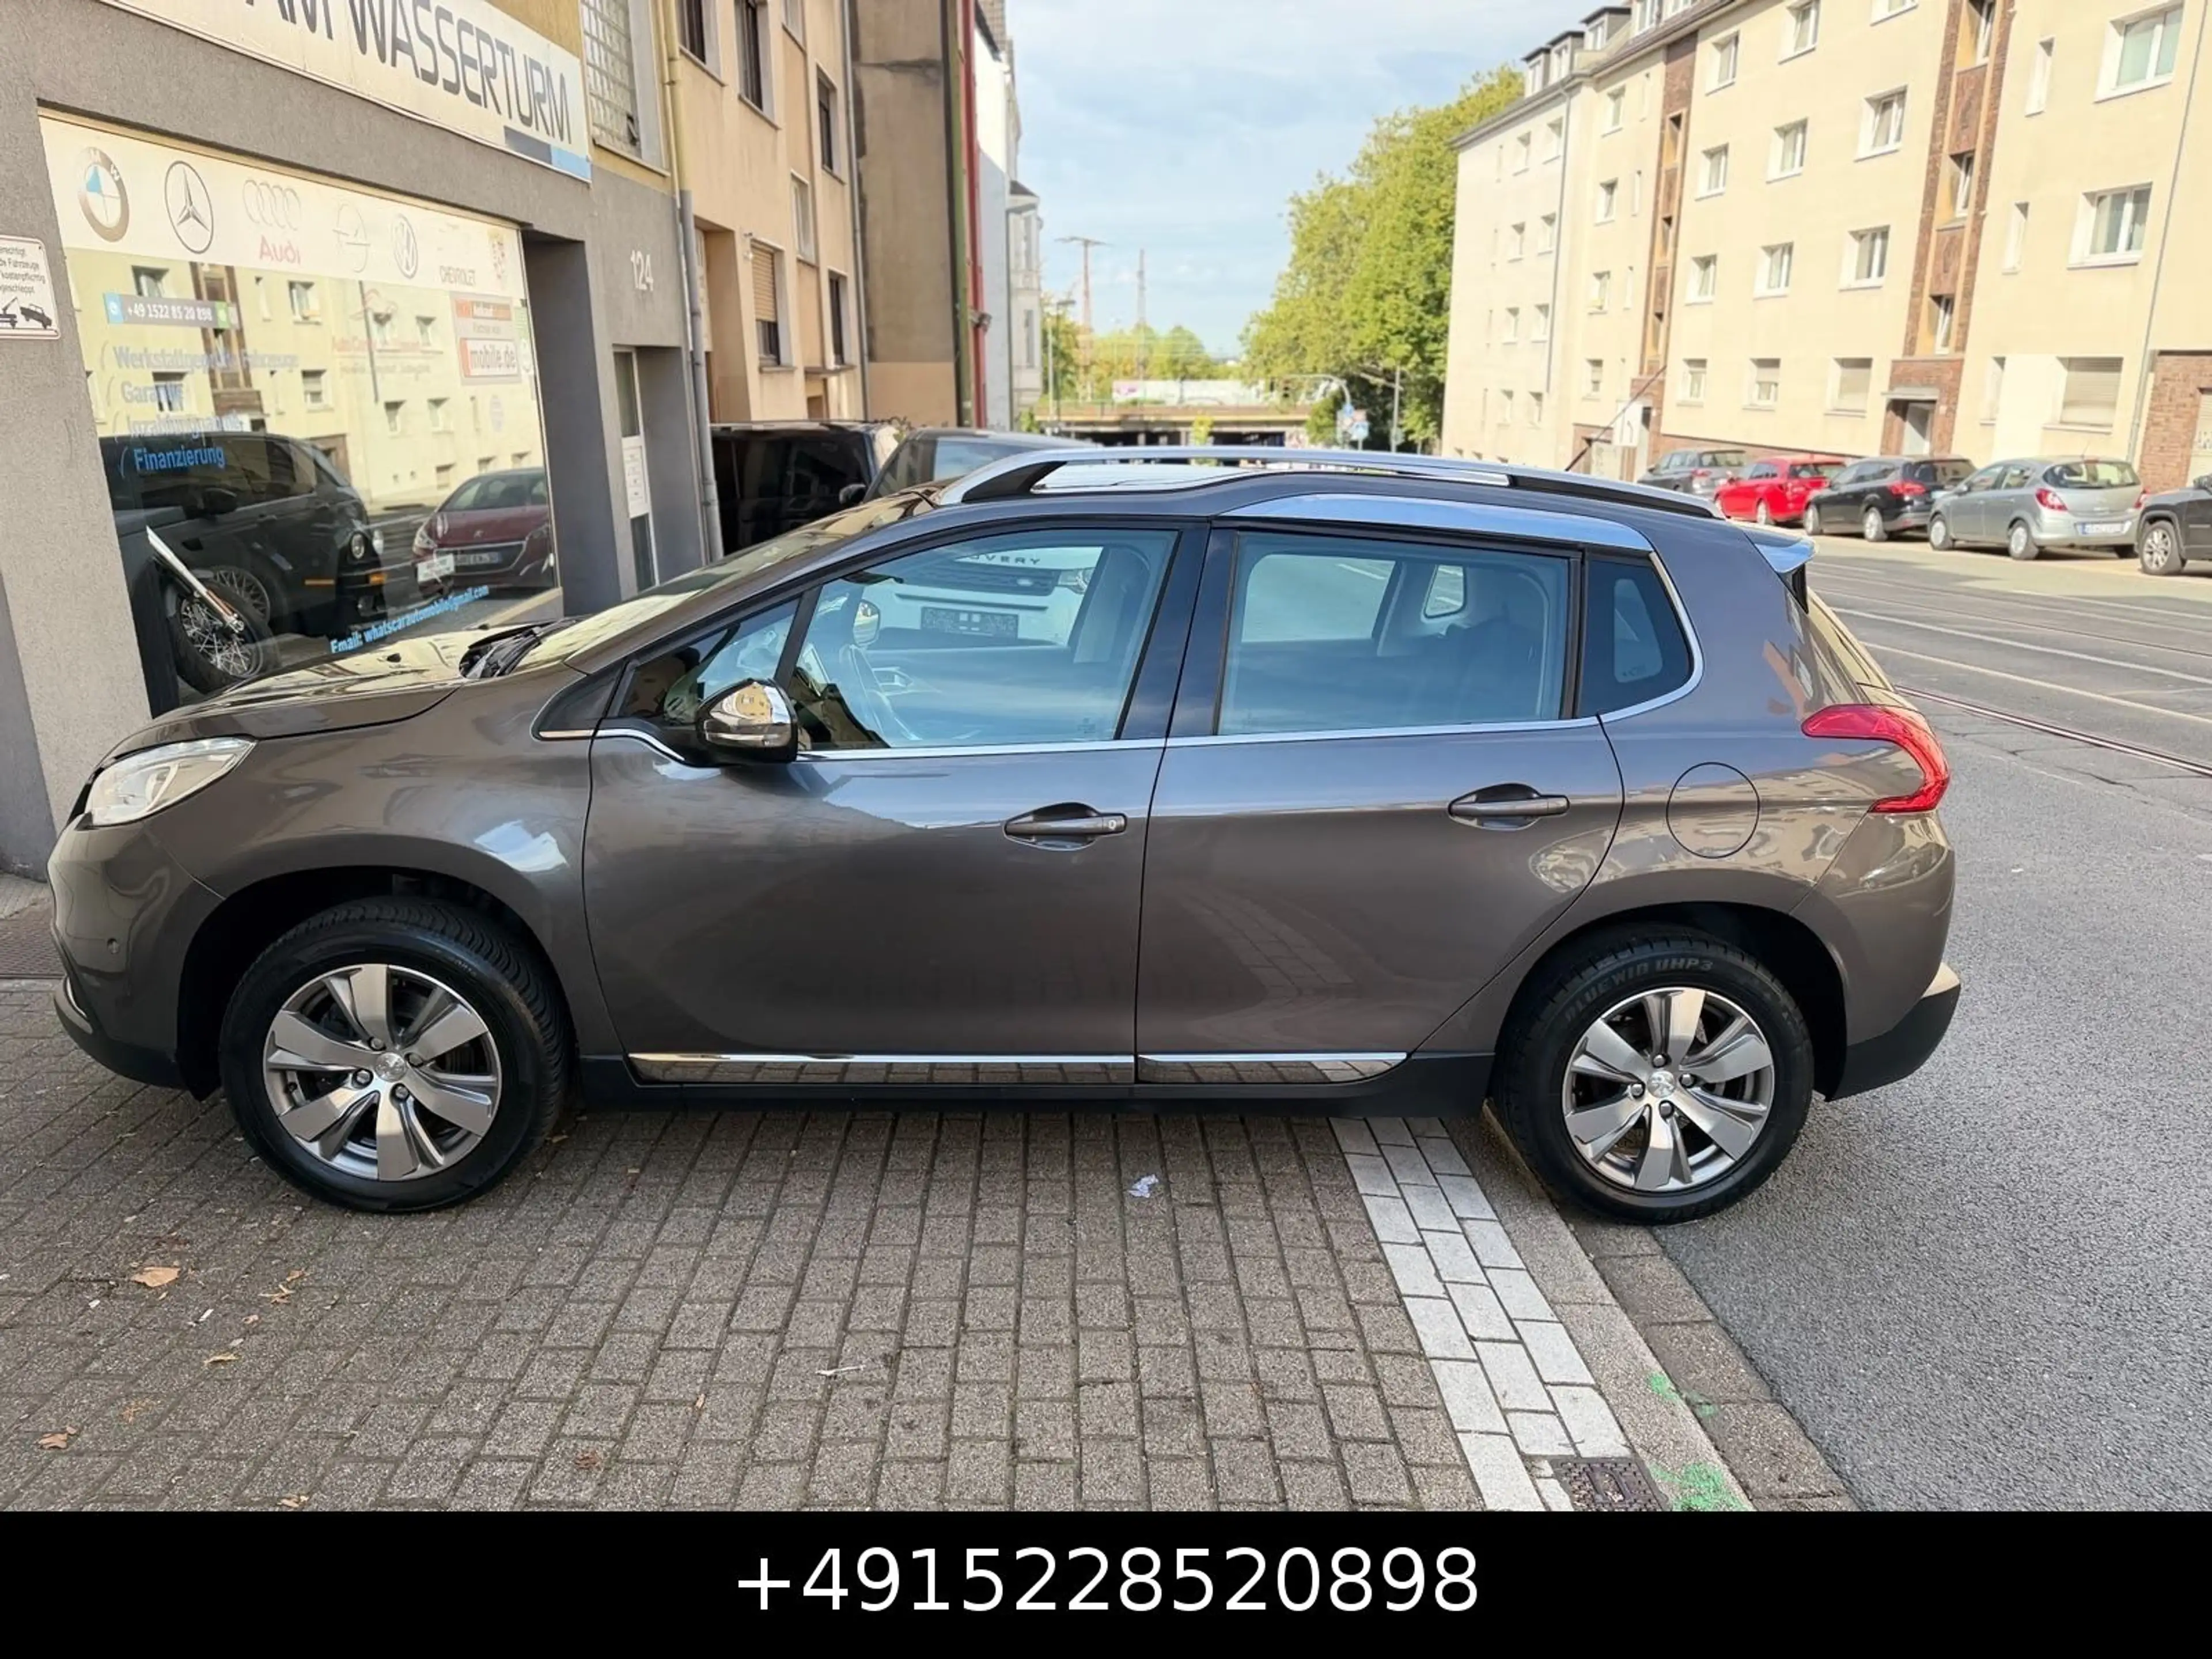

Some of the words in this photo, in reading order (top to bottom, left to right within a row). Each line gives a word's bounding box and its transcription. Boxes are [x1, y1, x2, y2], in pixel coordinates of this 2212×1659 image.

[348, 0, 572, 144] WASSERTURM
[260, 234, 301, 264] Audi
[630, 249, 654, 291] 124
[470, 344, 516, 370] mobile.de
[133, 445, 226, 472] Finanzierung
[330, 631, 363, 654] Email:
[1655, 957, 1714, 972] UHP3
